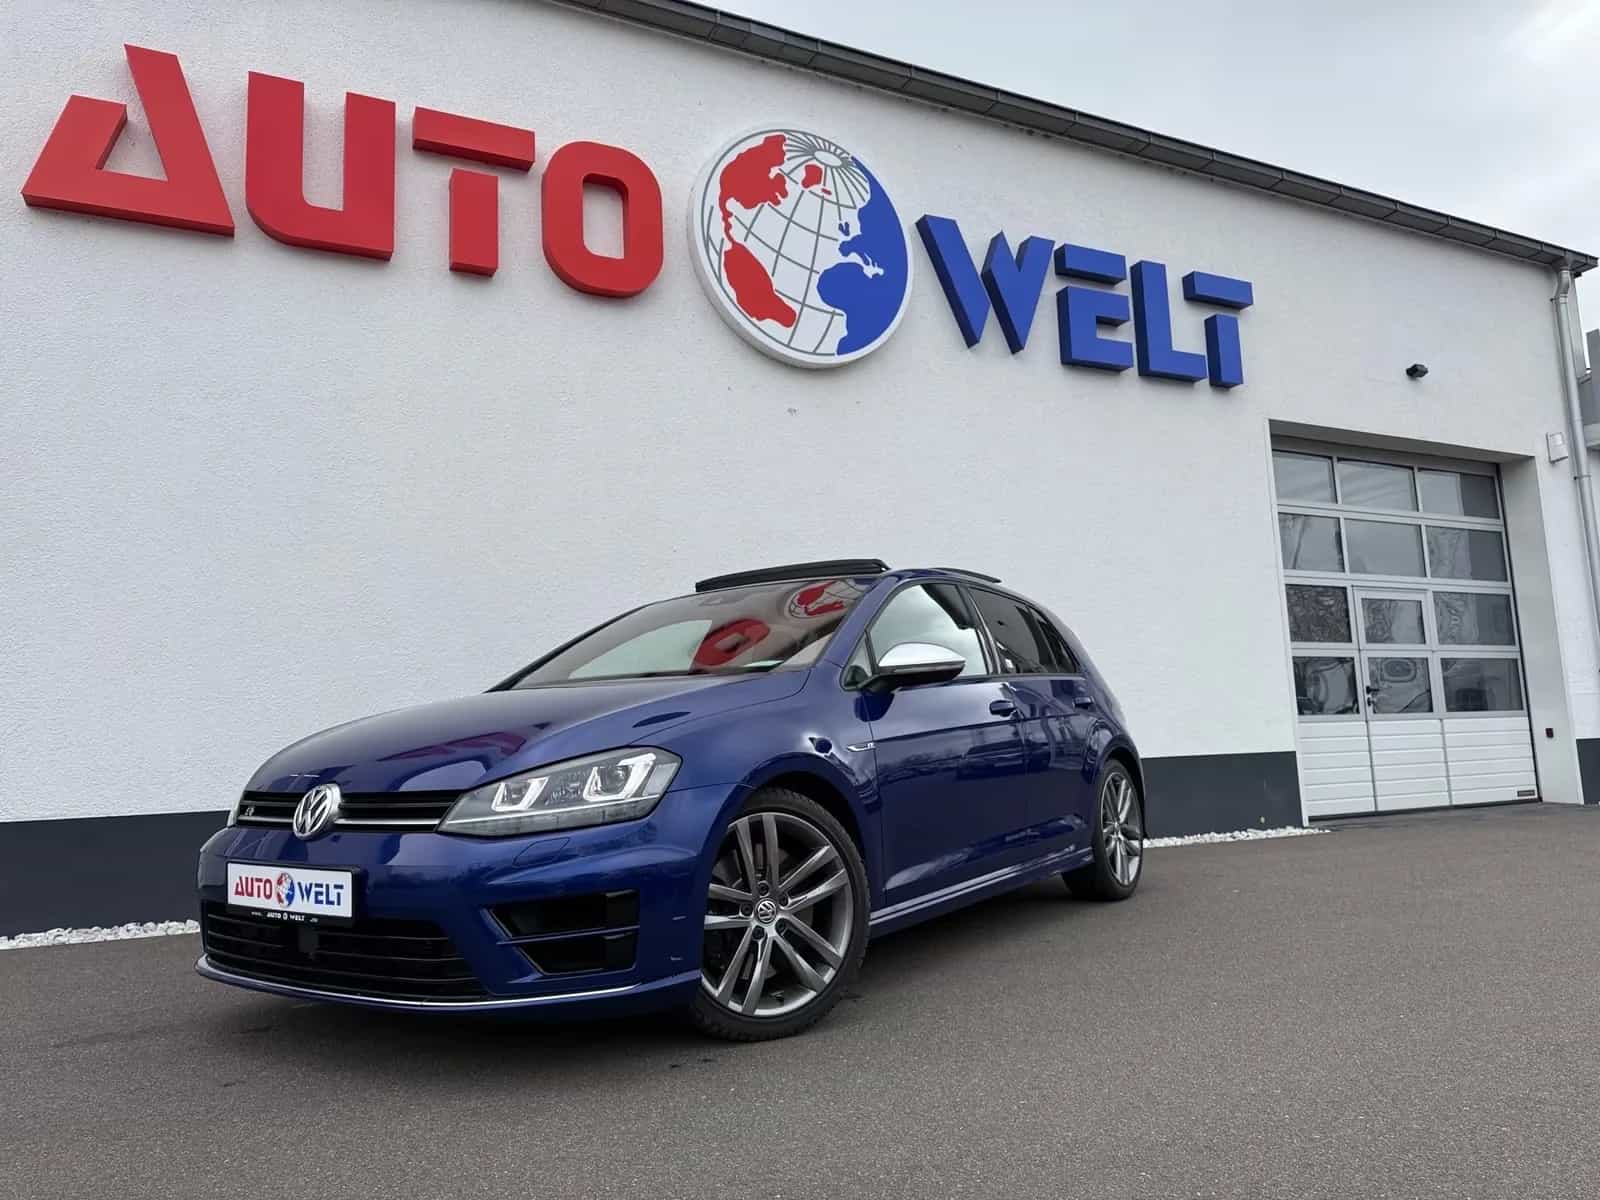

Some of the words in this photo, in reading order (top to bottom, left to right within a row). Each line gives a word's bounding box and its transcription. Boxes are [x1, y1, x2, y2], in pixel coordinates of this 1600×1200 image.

[21, 43, 664, 299] AUTO
[915, 213, 1255, 389] WELT
[234, 876, 272, 900] AUTO
[298, 882, 344, 906] WELT
